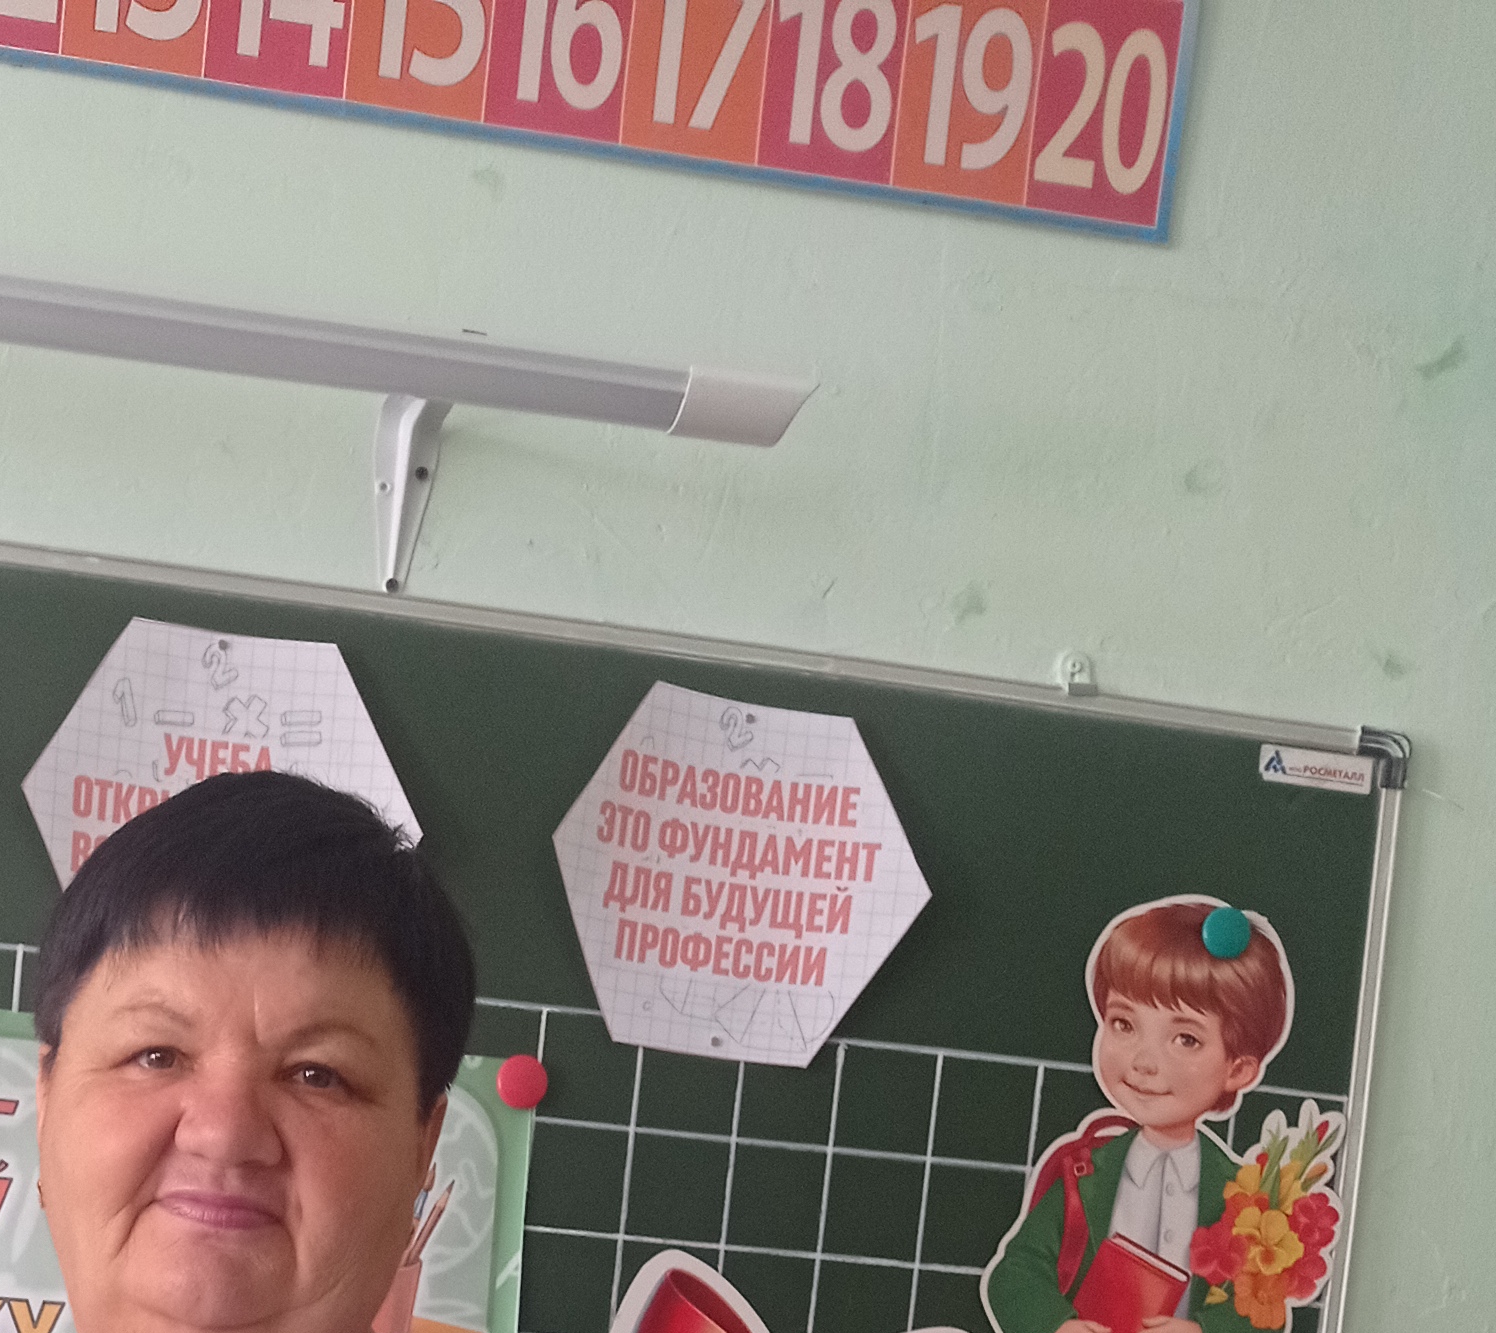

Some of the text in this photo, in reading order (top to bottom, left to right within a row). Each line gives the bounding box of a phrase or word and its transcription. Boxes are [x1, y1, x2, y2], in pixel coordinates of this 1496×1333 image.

[651, 0, 767, 131] 17
[778, 0, 894, 152] 18
[914, 3, 1034, 171] 19
[1033, 21, 1169, 196] 20
[618, 749, 861, 828] ОБРАЗОВАНИЕ
[596, 801, 882, 882] ЭТО ФУНДАМЕНТ
[602, 860, 853, 939] ДЛЯ БУДУЩЕЙ
[614, 918, 827, 987] ПРОФЕССИИ
